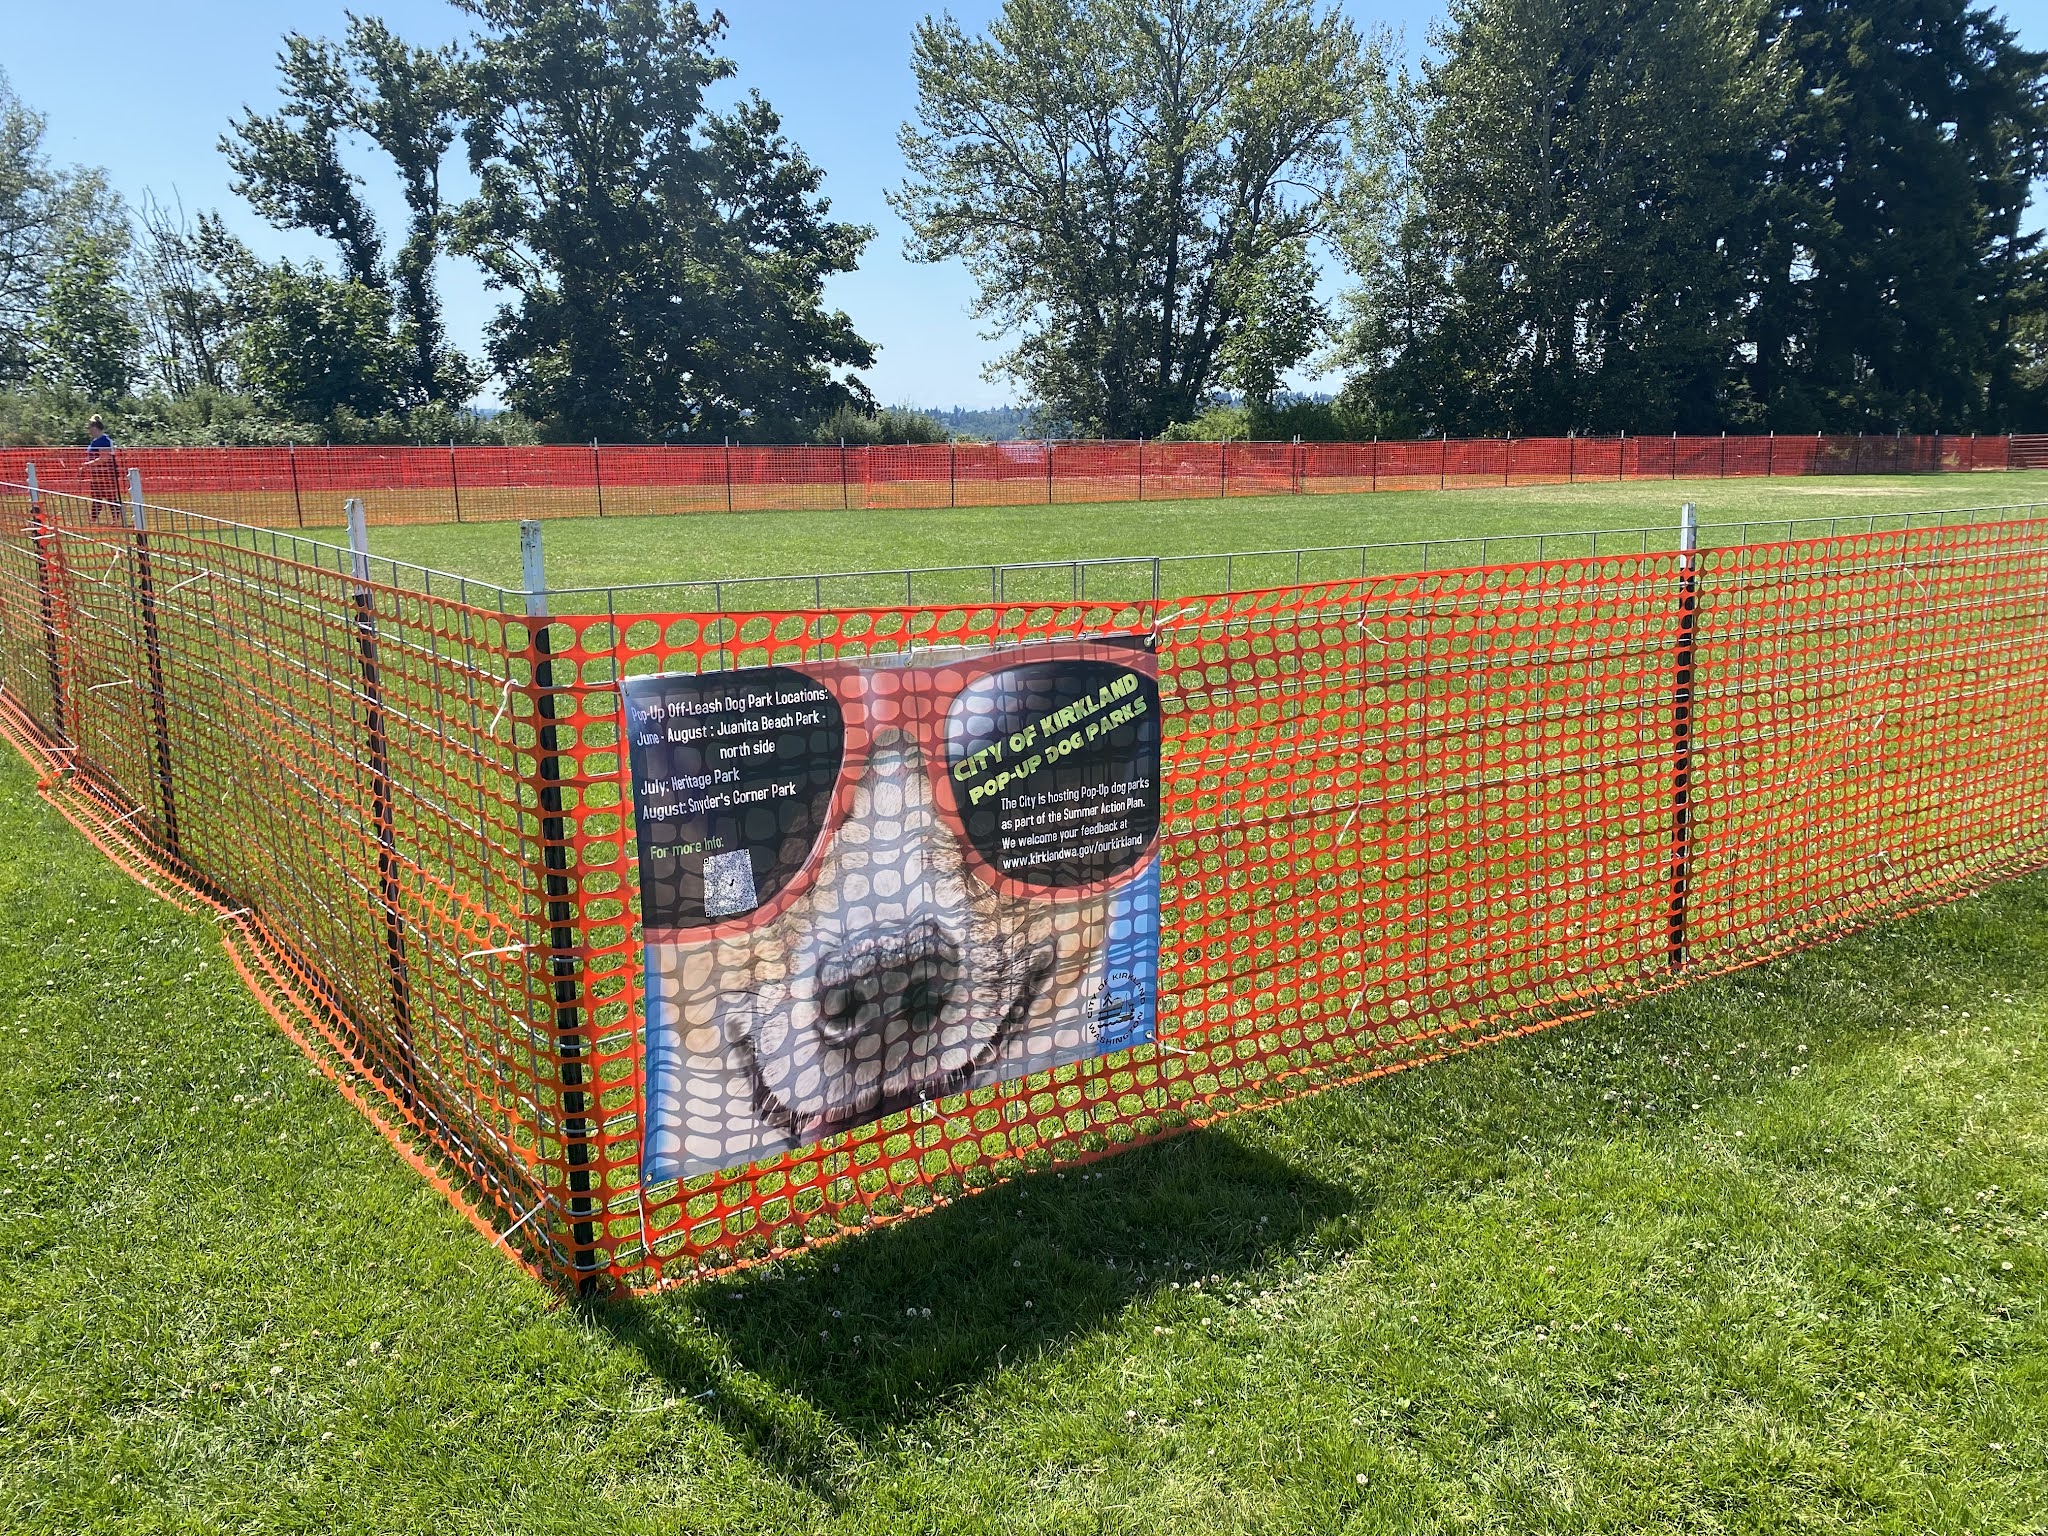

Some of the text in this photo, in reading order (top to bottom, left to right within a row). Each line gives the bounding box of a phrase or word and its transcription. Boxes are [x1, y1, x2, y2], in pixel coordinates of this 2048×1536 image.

[631, 688, 828, 724] Pop-Up Off-Leash Dog Park Locations:
[637, 731, 660, 746] June
[667, 725, 707, 745] August
[716, 719, 759, 737] Juanita
[761, 713, 794, 731] Beach
[795, 710, 820, 726] Park
[953, 673, 1139, 782] CITY OF KIRKLAND
[719, 739, 776, 760] north side
[968, 695, 1147, 806] POP-UP DOG PARKS
[640, 767, 741, 797] July: Heritage Park
[1001, 777, 1150, 811] The City is hosting Pop-Up dog parks
[642, 781, 797, 821] August: Snyder's Corner Park
[1001, 797, 1146, 831] as part of the Summer Action Plan.
[650, 835, 725, 860] For more Info:
[1001, 818, 1128, 850] We welcome your feedback at
[1002, 833, 1143, 869] www.kirklandwa.gov/ourkirkland
[1087, 972, 1146, 1019] CITY OF KIRKLAND
[1088, 1011, 1144, 1045] WASHINGTON
